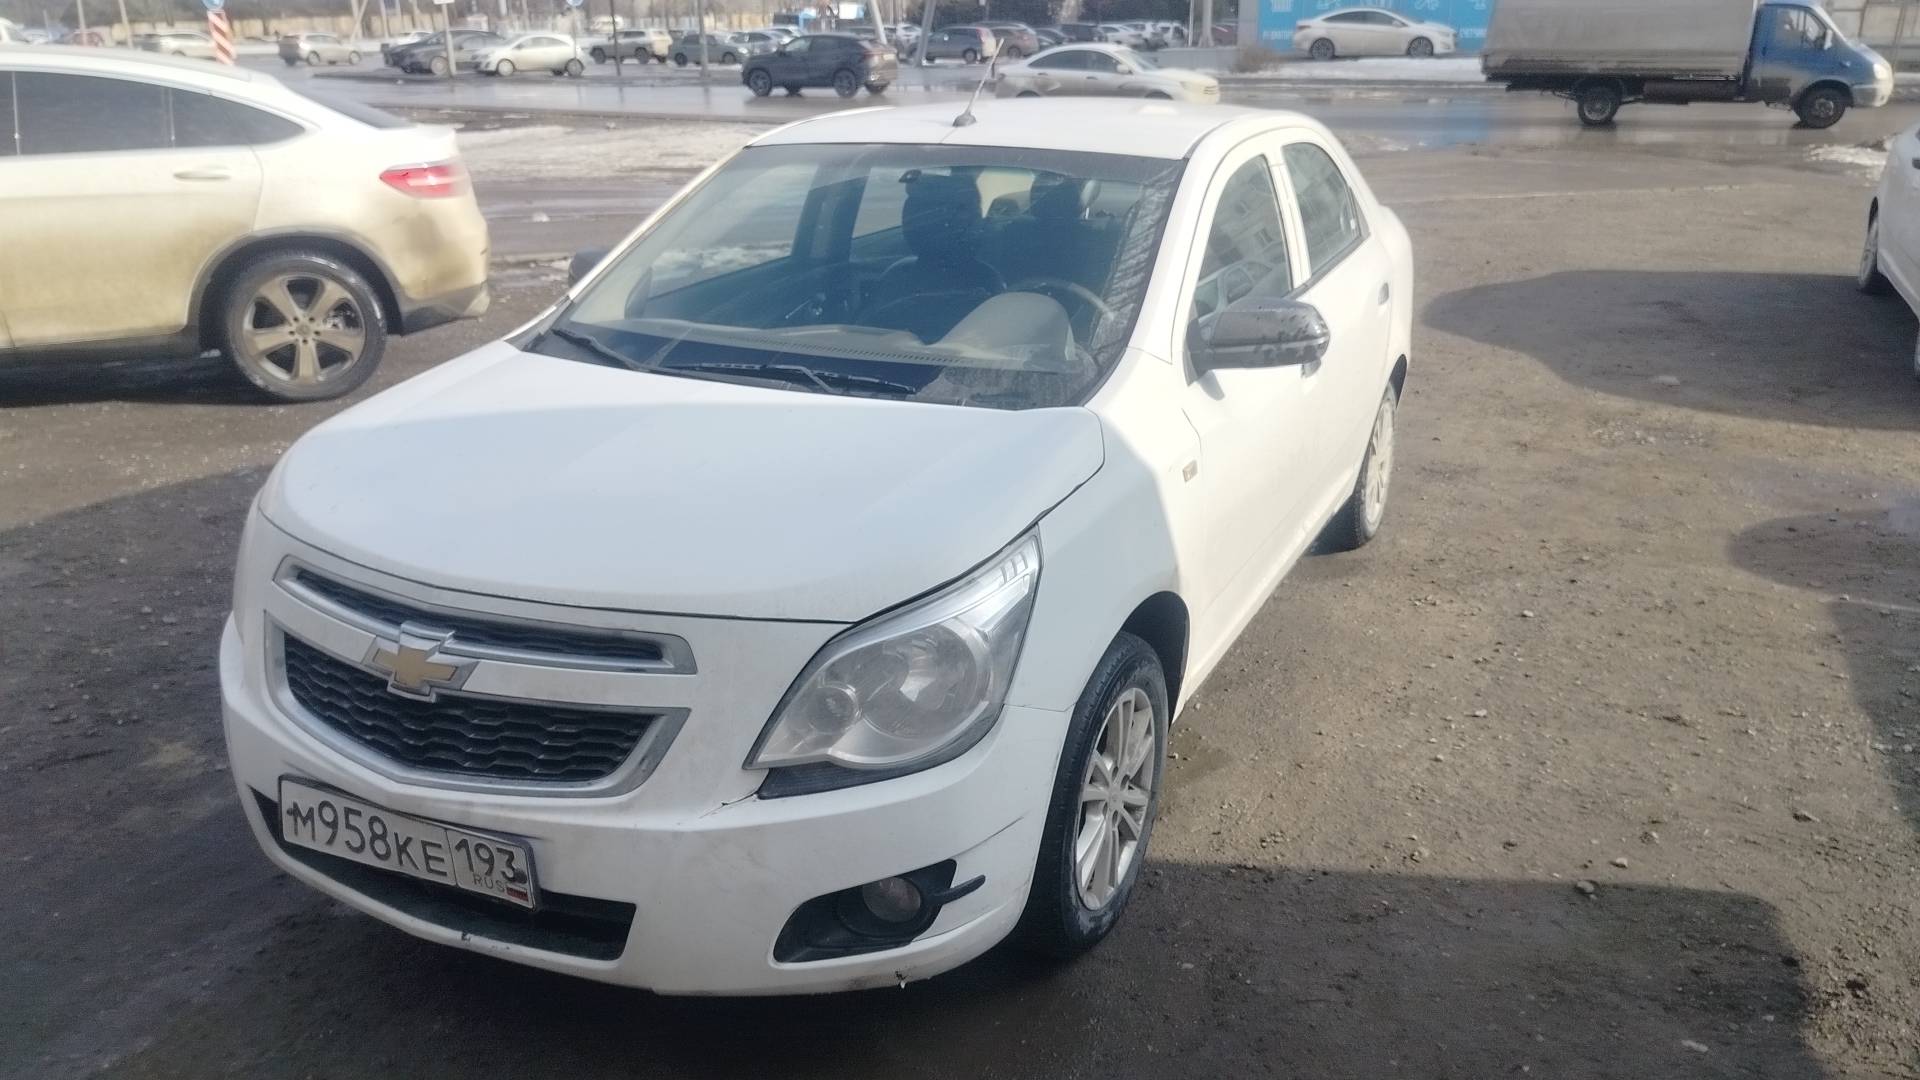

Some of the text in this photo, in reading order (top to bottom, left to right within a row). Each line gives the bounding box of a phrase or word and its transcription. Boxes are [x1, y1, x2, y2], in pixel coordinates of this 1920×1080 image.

[290, 800, 518, 884] М958КЕ 193
[472, 873, 506, 894] RUS
